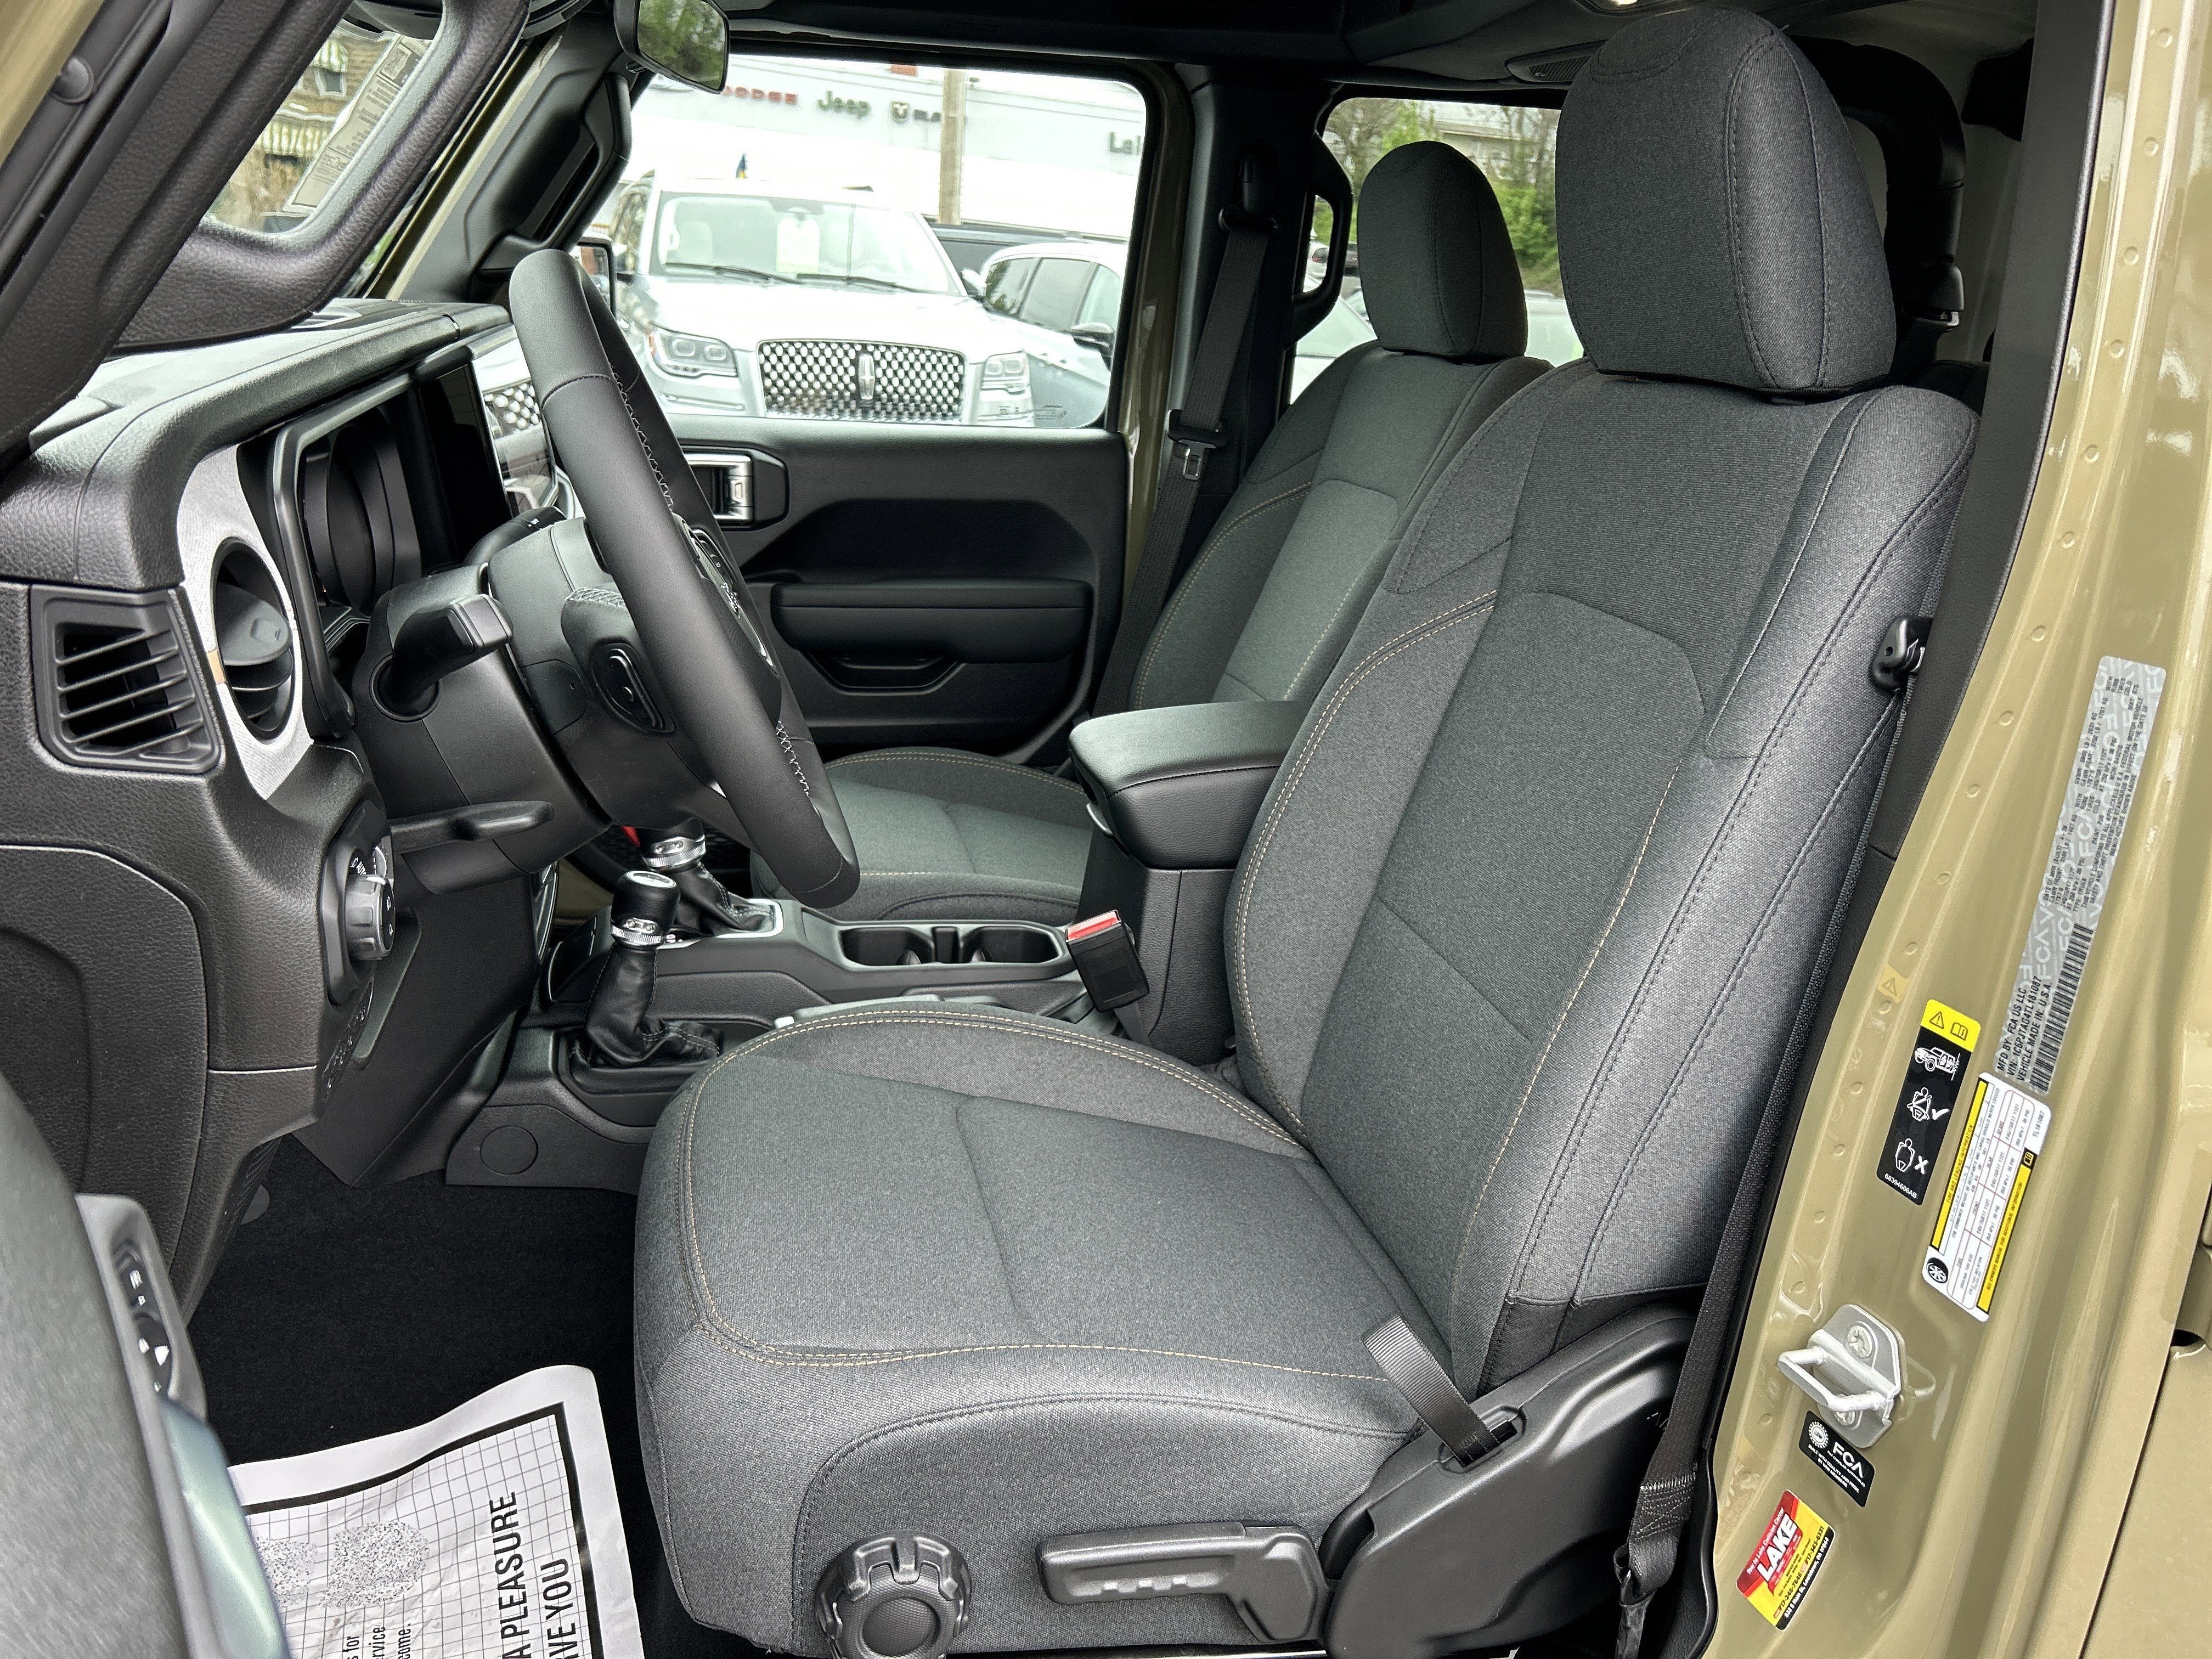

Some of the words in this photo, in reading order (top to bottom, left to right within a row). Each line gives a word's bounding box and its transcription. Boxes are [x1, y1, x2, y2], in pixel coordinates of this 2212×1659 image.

[817, 91, 871, 119] Jeep
[913, 109, 942, 122] RA
[2137, 714, 2145, 728] DATE
[2120, 743, 2130, 768] FEDERAL
[2132, 697, 2143, 719] VEHICLE
[2127, 774, 2136, 792] ABOVE
[2015, 987, 2025, 1003] LLC
[2038, 979, 2052, 1007] U.S.A.
[2011, 1003, 2021, 1016] US
[2033, 1007, 2044, 1021] IN:
[2007, 1017, 2017, 1034] FCA
[2027, 1022, 2040, 1047] MADE
[2002, 1036, 2012, 1051] BY:
[1997, 1052, 2008, 1071] MFD
[2007, 1058, 2019, 1076] VIN:
[2017, 1047, 2033, 1082] VEHICLE
[1953, 1158, 1962, 1180] LOADING
[1960, 1124, 1972, 1158] INFORMATION
[1833, 1441, 1863, 1479] FCA
[1746, 1562, 1754, 1575] Tow
[1751, 1556, 1758, 1565] to
[1755, 1544, 1765, 1559] Lake
[1762, 1523, 1776, 1546] Collision
[1773, 1506, 1785, 1525] Center
[1754, 1513, 1799, 1582] LAKE
[489, 1491, 530, 1640] PLEASURE
[540, 1558, 573, 1621] YOU
[342, 1635, 359, 1652] for
[368, 1626, 386, 1659] rvice
[501, 1643, 532, 1658] A
